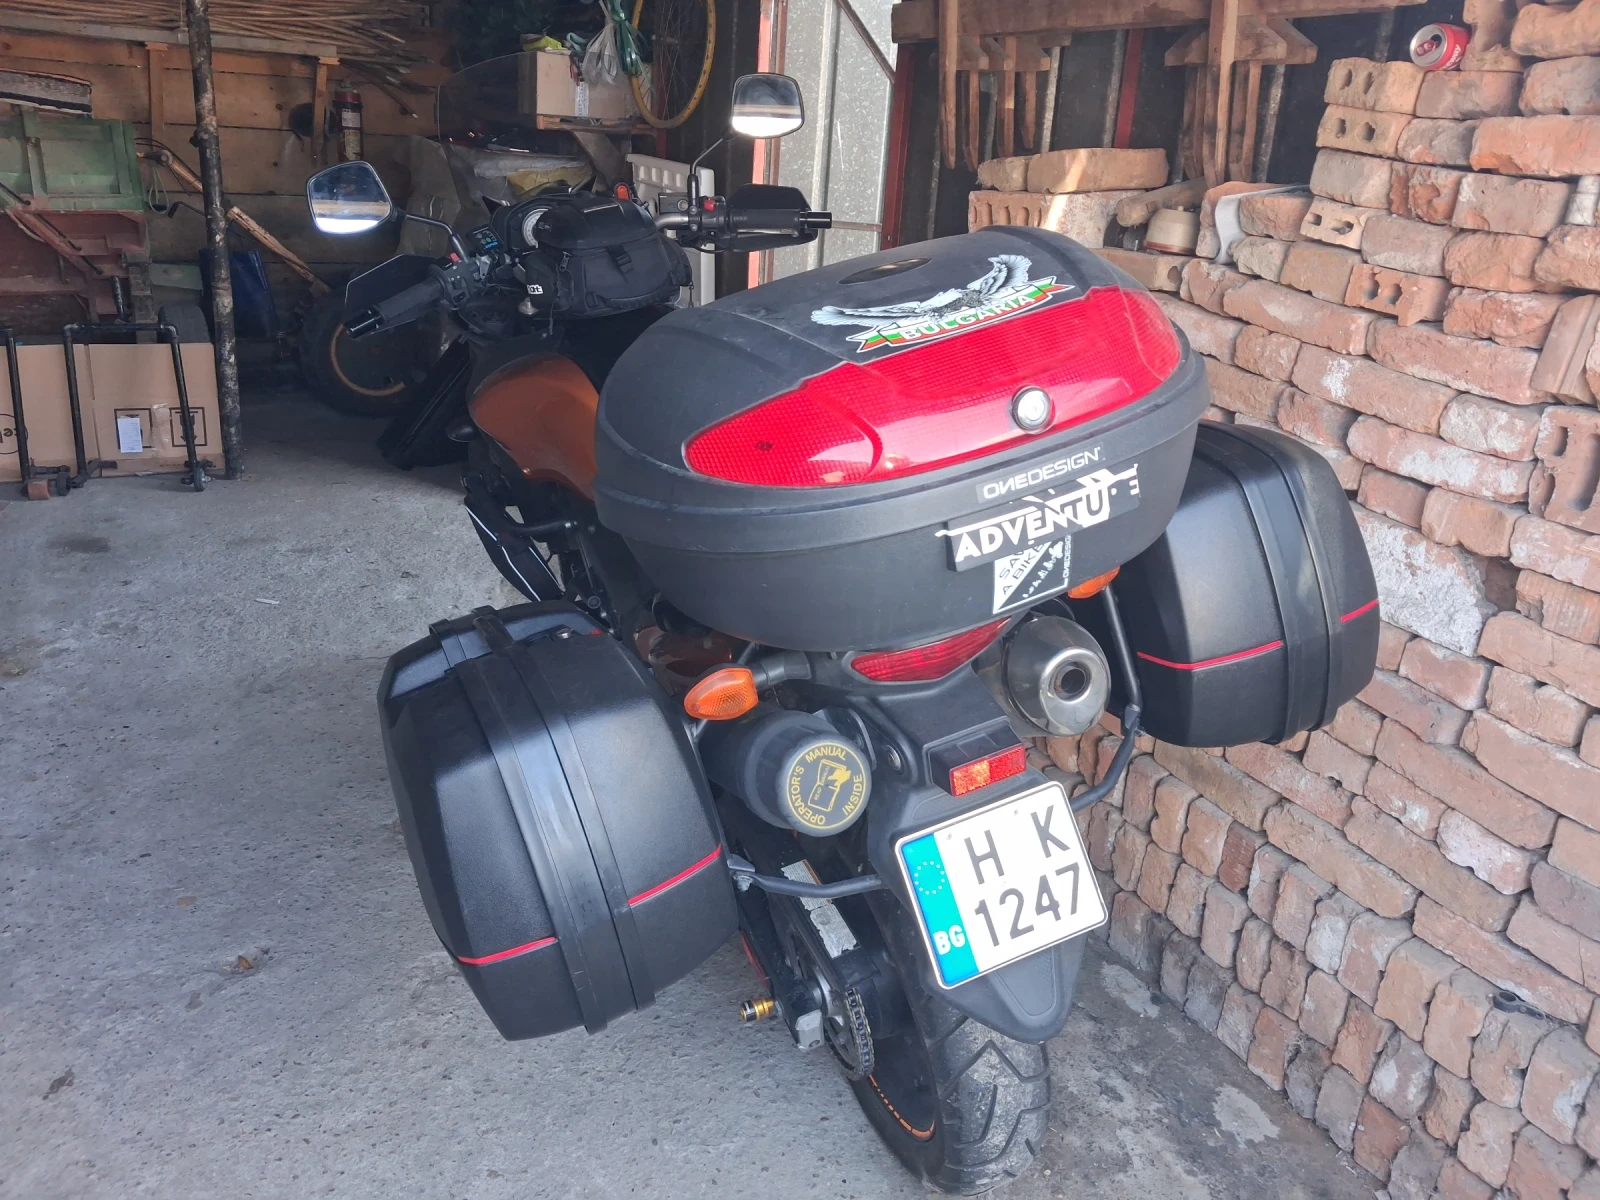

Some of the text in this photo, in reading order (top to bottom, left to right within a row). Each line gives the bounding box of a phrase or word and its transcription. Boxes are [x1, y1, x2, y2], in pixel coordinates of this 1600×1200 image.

[898, 294, 1036, 340] BULGARIA
[982, 447, 1100, 500] ONEDESIGN
[1002, 543, 1046, 596] A BIKE
[791, 746, 863, 825] OPERATOR'S MANUAL INSIDE
[964, 804, 1071, 885] H K
[974, 861, 1080, 947] 1247
[933, 924, 966, 955] BG
